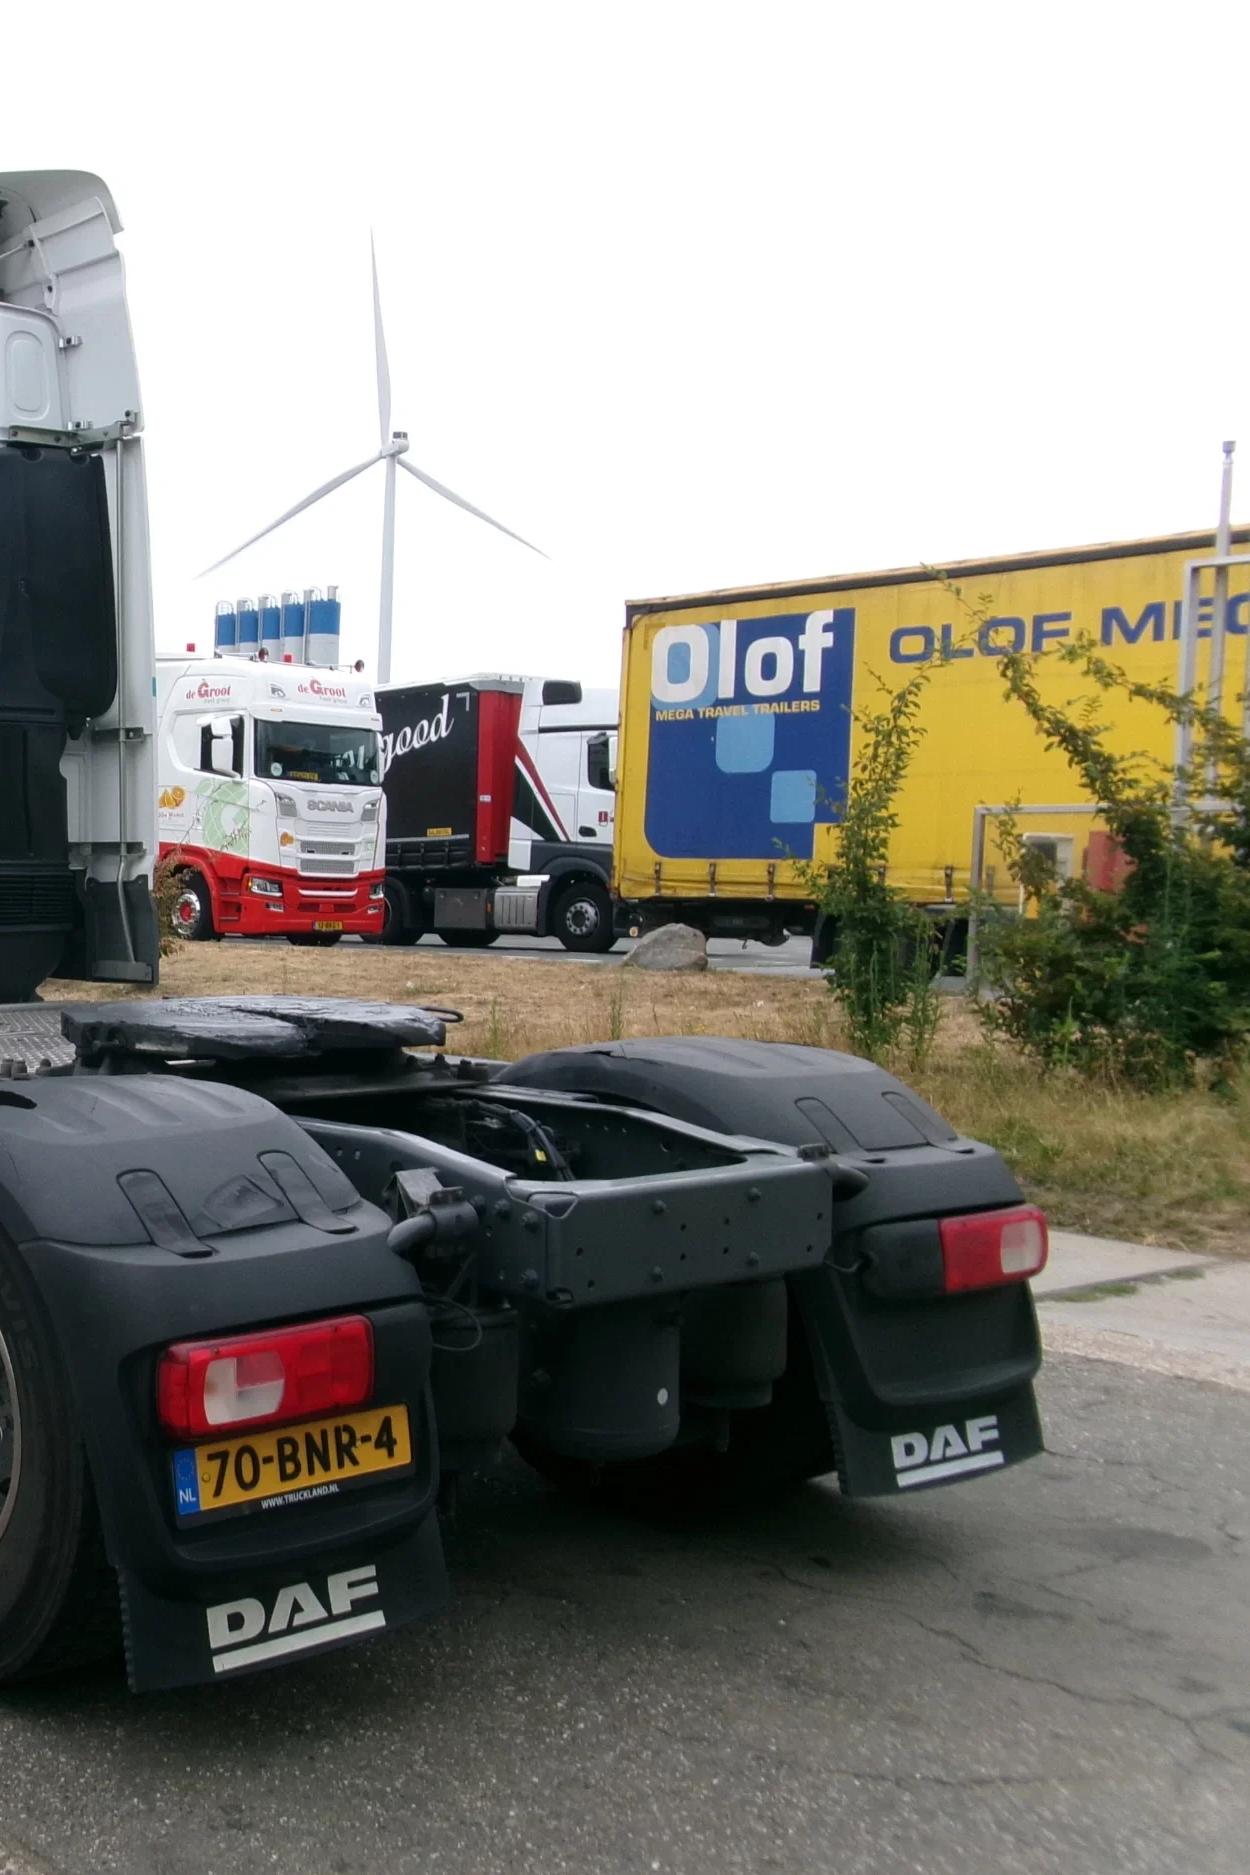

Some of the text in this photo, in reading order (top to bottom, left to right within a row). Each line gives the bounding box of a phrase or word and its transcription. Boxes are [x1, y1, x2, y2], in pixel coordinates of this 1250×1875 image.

[650, 608, 834, 704] Olof
[888, 611, 1072, 665] OLOF
[186, 681, 231, 700] de Groot
[297, 679, 346, 698] de Groot
[655, 699, 821, 721] MEGA TRAVEL TRAILERS
[306, 799, 354, 813] SCANIA
[179, 1415, 398, 1505] NL 70-BNR-4
[890, 1415, 1000, 1470] DAF
[260, 1483, 340, 1510] WWW.TRUCKLAND.NL
[206, 1564, 380, 1649] DAF
